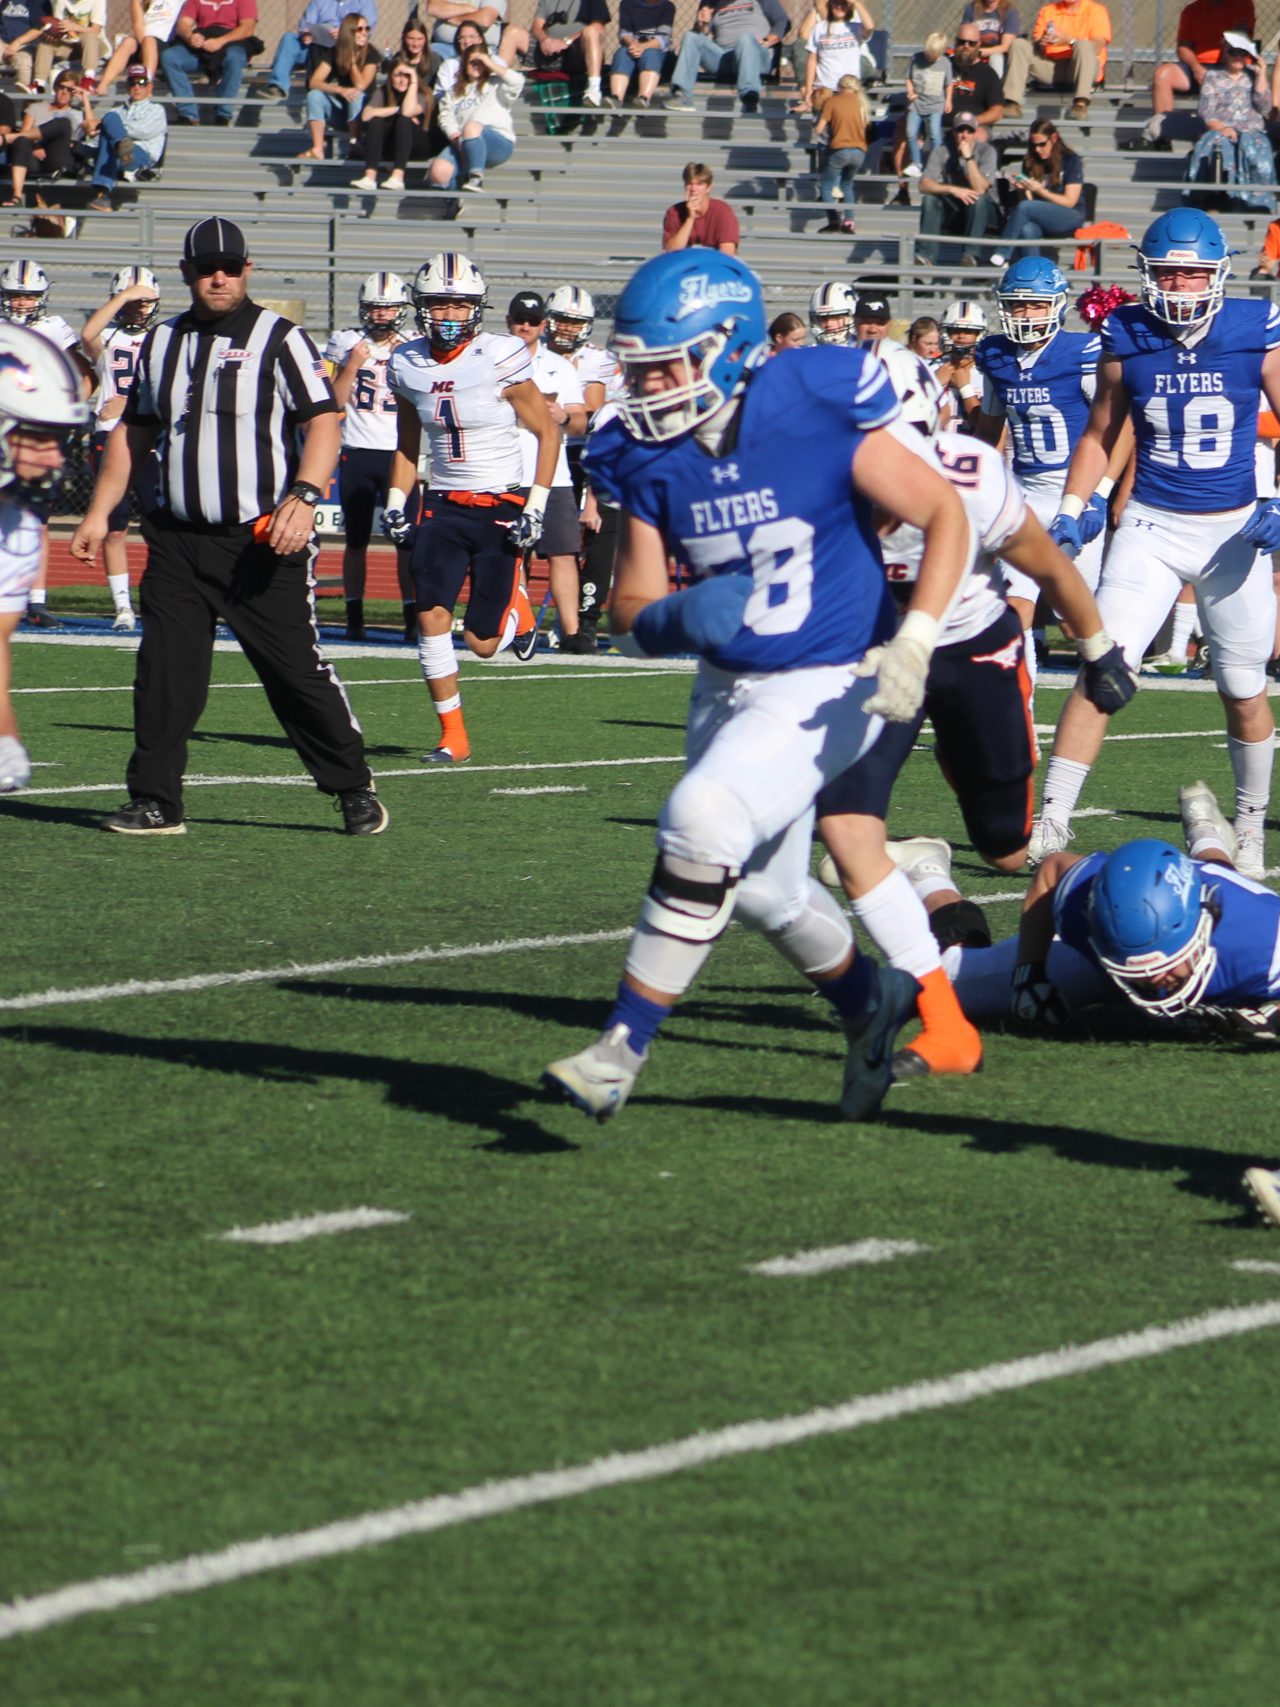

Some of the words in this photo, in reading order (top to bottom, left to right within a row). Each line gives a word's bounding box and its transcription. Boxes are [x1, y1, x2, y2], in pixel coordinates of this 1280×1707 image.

[679, 273, 753, 312] Flyers
[430, 380, 455, 394] MC
[1006, 387, 1051, 404] FLYERS
[1155, 372, 1223, 394] FLYERS
[434, 396, 466, 462] 1
[1005, 404, 1070, 465] 10
[1143, 395, 1235, 470] 18
[690, 487, 780, 534] FLYERS
